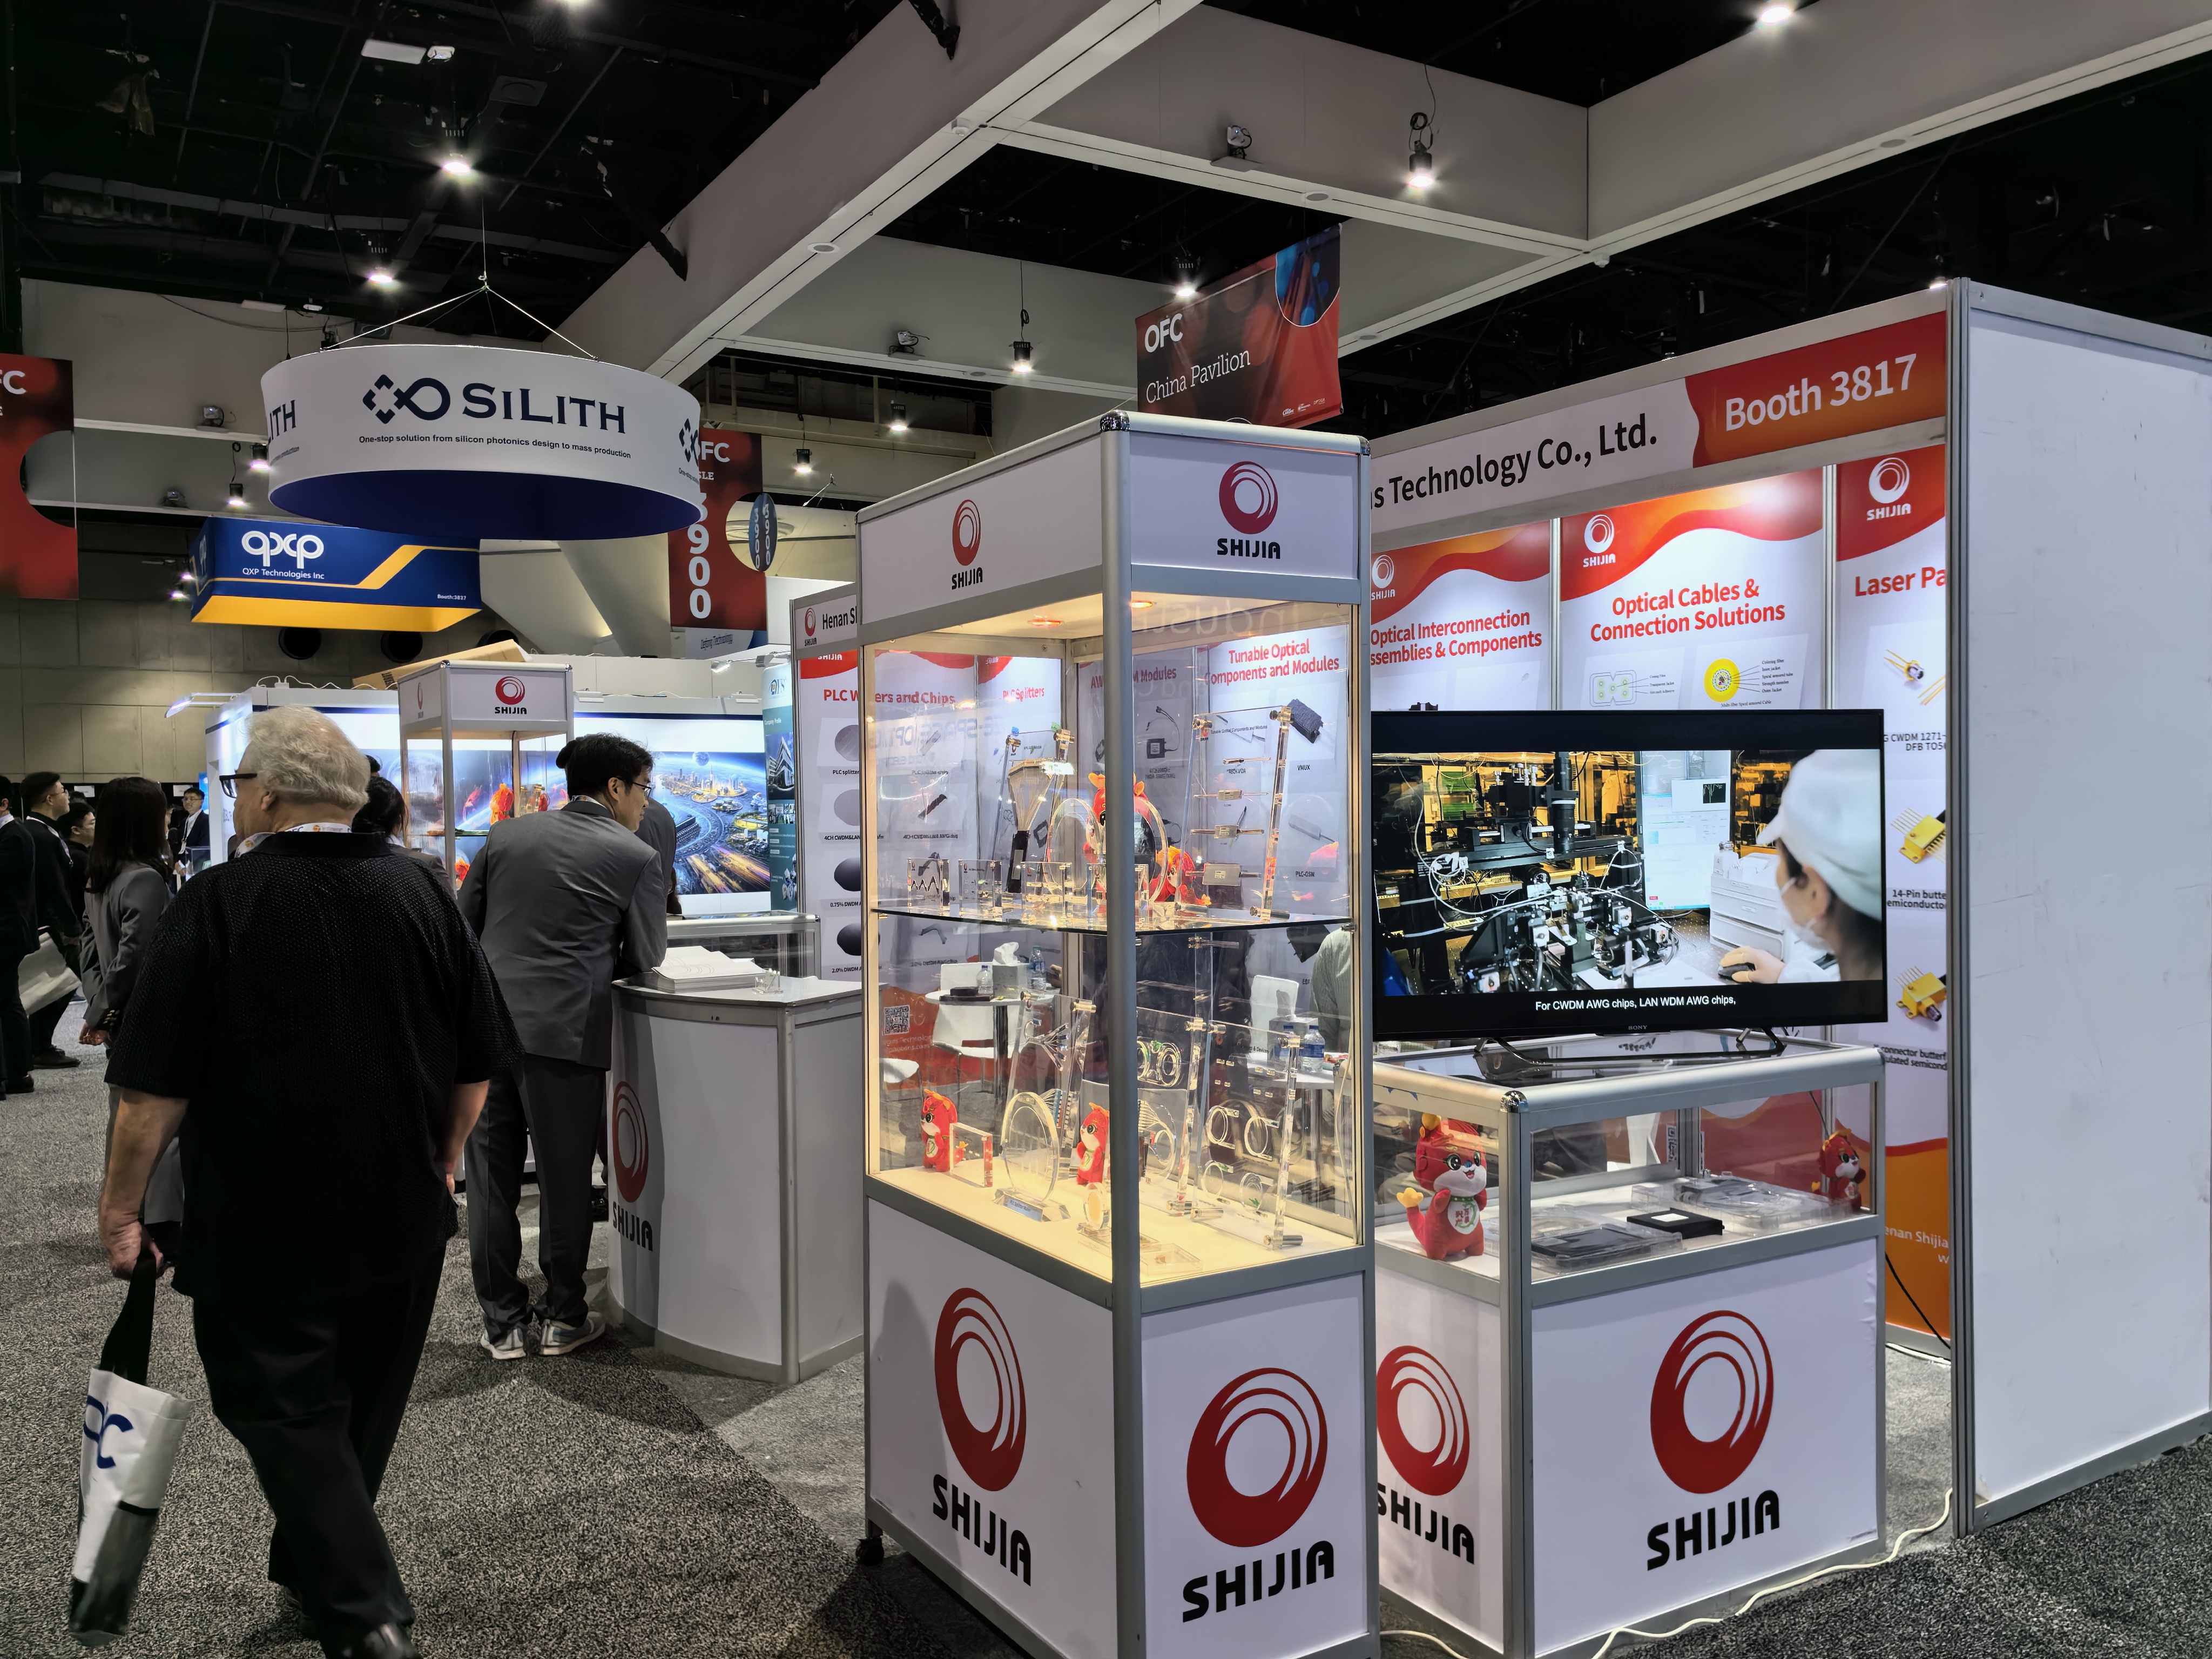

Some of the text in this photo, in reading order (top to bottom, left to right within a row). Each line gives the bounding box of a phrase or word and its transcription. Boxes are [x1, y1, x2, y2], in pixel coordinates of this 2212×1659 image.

[1144, 313, 1183, 353] OFC
[1146, 349, 1251, 404] China Pavilion
[1726, 354, 1917, 431] Booth 3817
[359, 435, 394, 443] One-stop
[455, 435, 484, 443] silicon
[487, 437, 530, 446] photonics
[532, 439, 559, 449] design
[572, 444, 592, 452] mass
[594, 447, 631, 458] production
[699, 441, 730, 462] FC
[1389, 450, 1531, 504] Technology
[1537, 438, 1591, 468] Co.,
[1599, 413, 1657, 456] Ltd.
[1867, 503, 1911, 521] SHIJIA
[1217, 538, 1281, 559] SHIJIA
[1583, 553, 1616, 568] SHIJIA
[261, 569, 312, 579] Technologies
[952, 567, 983, 590] SHIJIA
[1855, 572, 1916, 597] Laser
[1371, 589, 1395, 601] SHIJIA
[1613, 578, 1759, 618] Optical Cables &
[822, 611, 848, 630] Henan
[1370, 609, 1530, 648] Optical Interconnection
[1590, 603, 1785, 642] Connection Solutions
[1229, 638, 1310, 664] Tunable Optical
[1370, 630, 1542, 666] ssemblies & Components
[1141, 666, 1177, 683] Modules
[1204, 655, 1339, 686] Components and Modules
[824, 689, 848, 701] PLC
[896, 691, 920, 703] and
[921, 691, 955, 706] Chips
[1016, 687, 1044, 702] Splitters
[494, 706, 527, 714] SHIJIA
[1891, 733, 1918, 743] CWDM
[1906, 741, 1946, 751] DFB TO5
[1887, 899, 1946, 909] emiconducto
[1892, 889, 1921, 899] 14-Pin
[1535, 995, 1736, 1010] For CWDM AWG chips, LAN WDM AWG chips,
[612, 1200, 653, 1252] SHIJIA
[933, 1474, 1031, 1587] SHIJIA
[1377, 1482, 1475, 1565] SHIJIA
[1647, 1489, 1780, 1572] SHIJIA
[1183, 1540, 1334, 1623] SHIJIA
